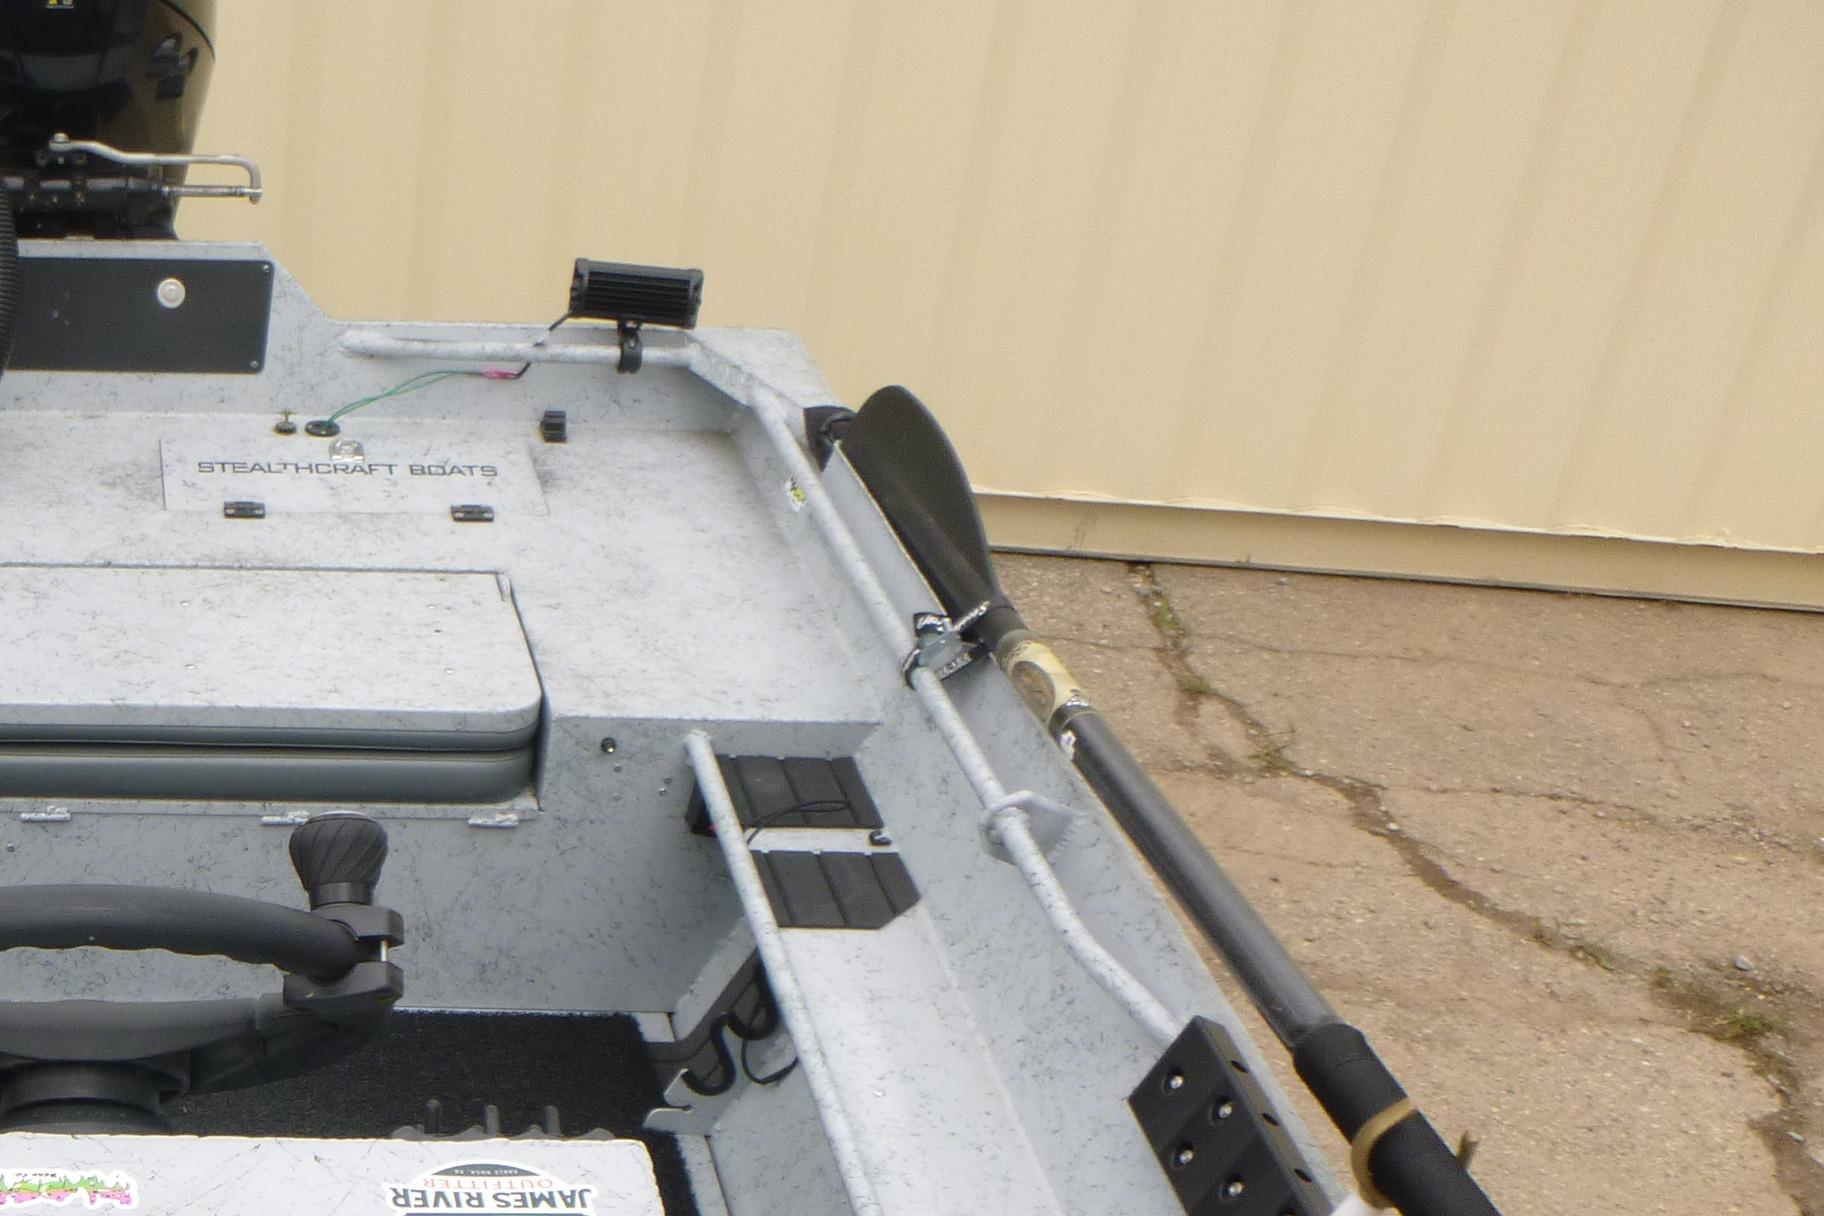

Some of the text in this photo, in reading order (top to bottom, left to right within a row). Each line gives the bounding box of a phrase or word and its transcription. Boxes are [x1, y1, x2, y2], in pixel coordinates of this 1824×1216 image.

[197, 461, 498, 477] STEALTHCRAFT BOATS
[423, 1178, 553, 1190] OUTFITTER
[389, 1187, 591, 1209] JAMES RIVER
